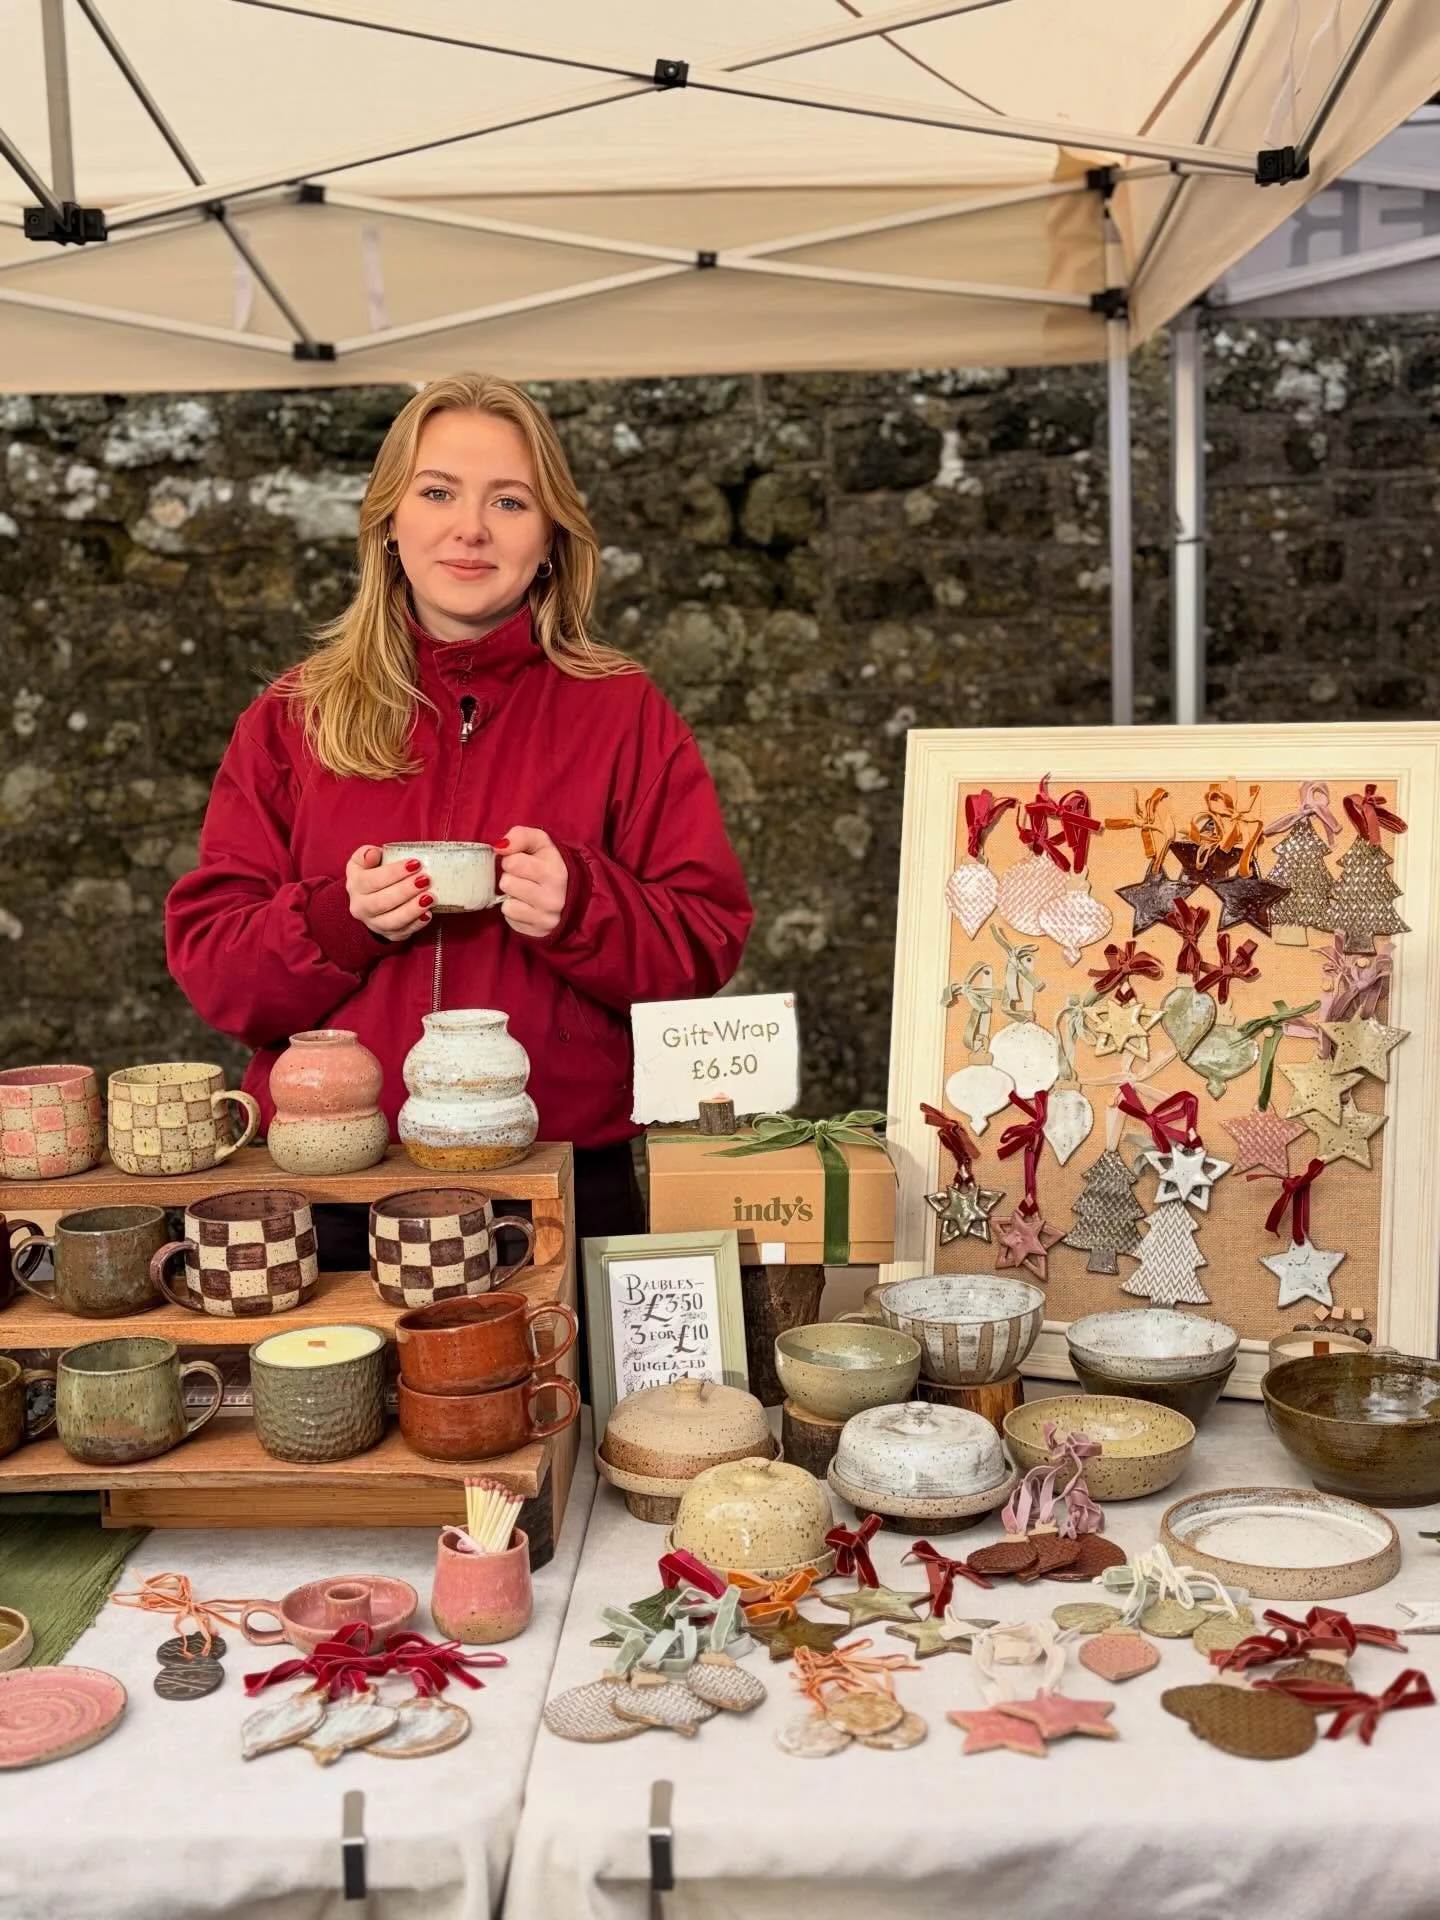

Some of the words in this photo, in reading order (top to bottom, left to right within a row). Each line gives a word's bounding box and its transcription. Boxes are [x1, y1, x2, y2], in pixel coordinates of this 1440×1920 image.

[662, 1023, 709, 1048] Gift
[713, 1018, 780, 1043] Wrap
[692, 1053, 758, 1080] £6.50
[732, 1196, 814, 1226] indy's
[630, 1324, 647, 1345] 3
[650, 1330, 678, 1342] FOR
[674, 1323, 709, 1353] £10
[632, 1359, 706, 1372] UNGLAZED
